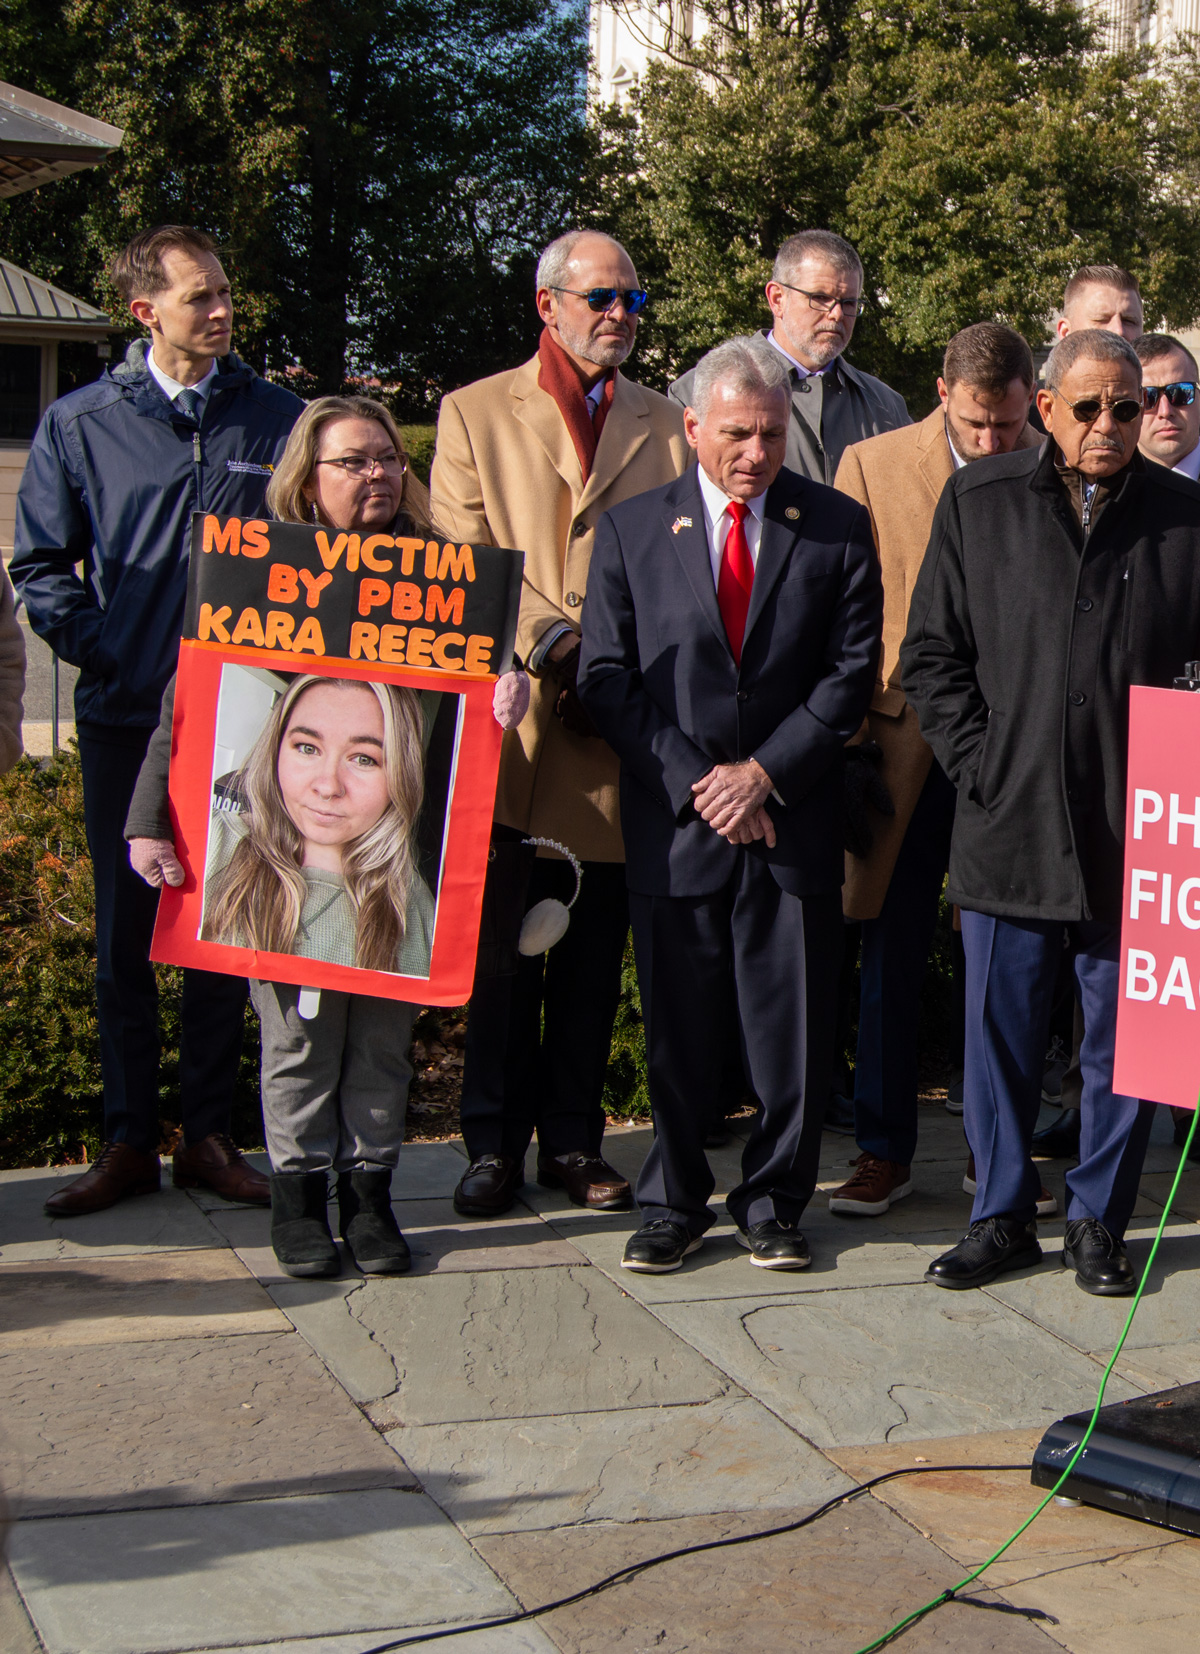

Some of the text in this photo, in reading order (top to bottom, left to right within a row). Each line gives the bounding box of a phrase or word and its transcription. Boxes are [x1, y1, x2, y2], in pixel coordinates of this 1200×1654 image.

[203, 515, 476, 583] MS VICTIM
[267, 563, 466, 625] BY PBM
[198, 602, 495, 674] KARA REECE
